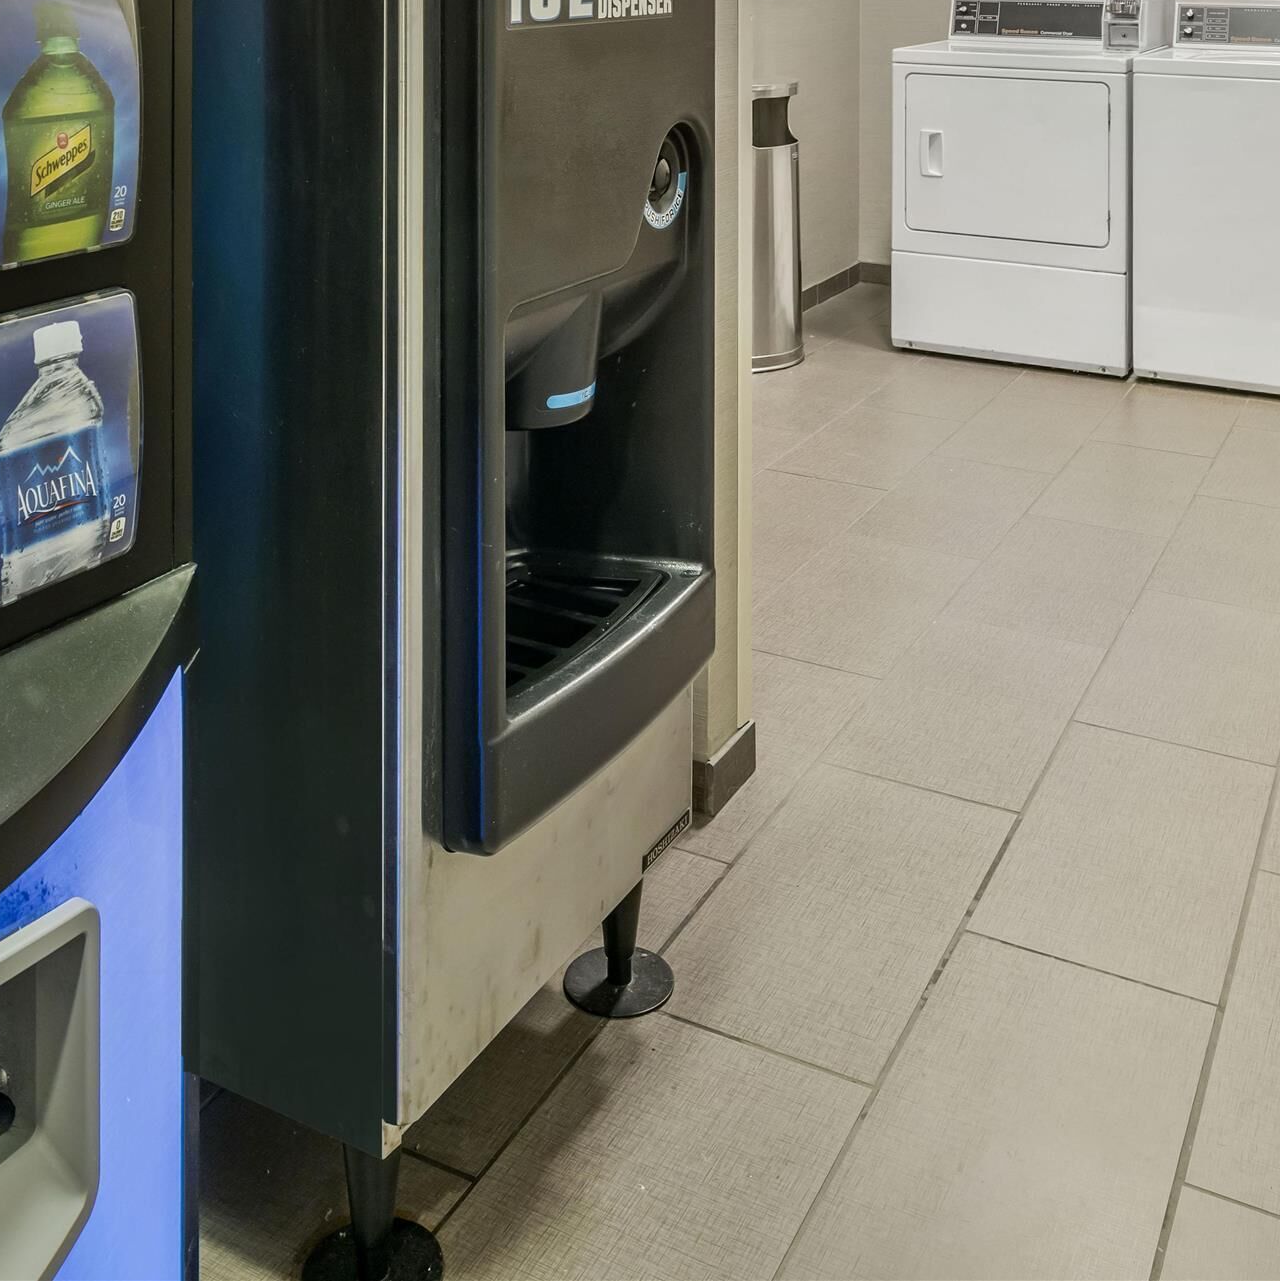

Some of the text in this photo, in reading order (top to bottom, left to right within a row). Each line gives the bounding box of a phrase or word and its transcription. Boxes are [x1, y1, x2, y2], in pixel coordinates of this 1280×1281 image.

[35, 138, 88, 187] Schweppes
[114, 185, 127, 198] 20
[45, 195, 86, 209] GINGER ALE
[661, 208, 674, 224] FOR
[17, 461, 97, 526] AQUAFINA
[113, 494, 126, 509] 20
